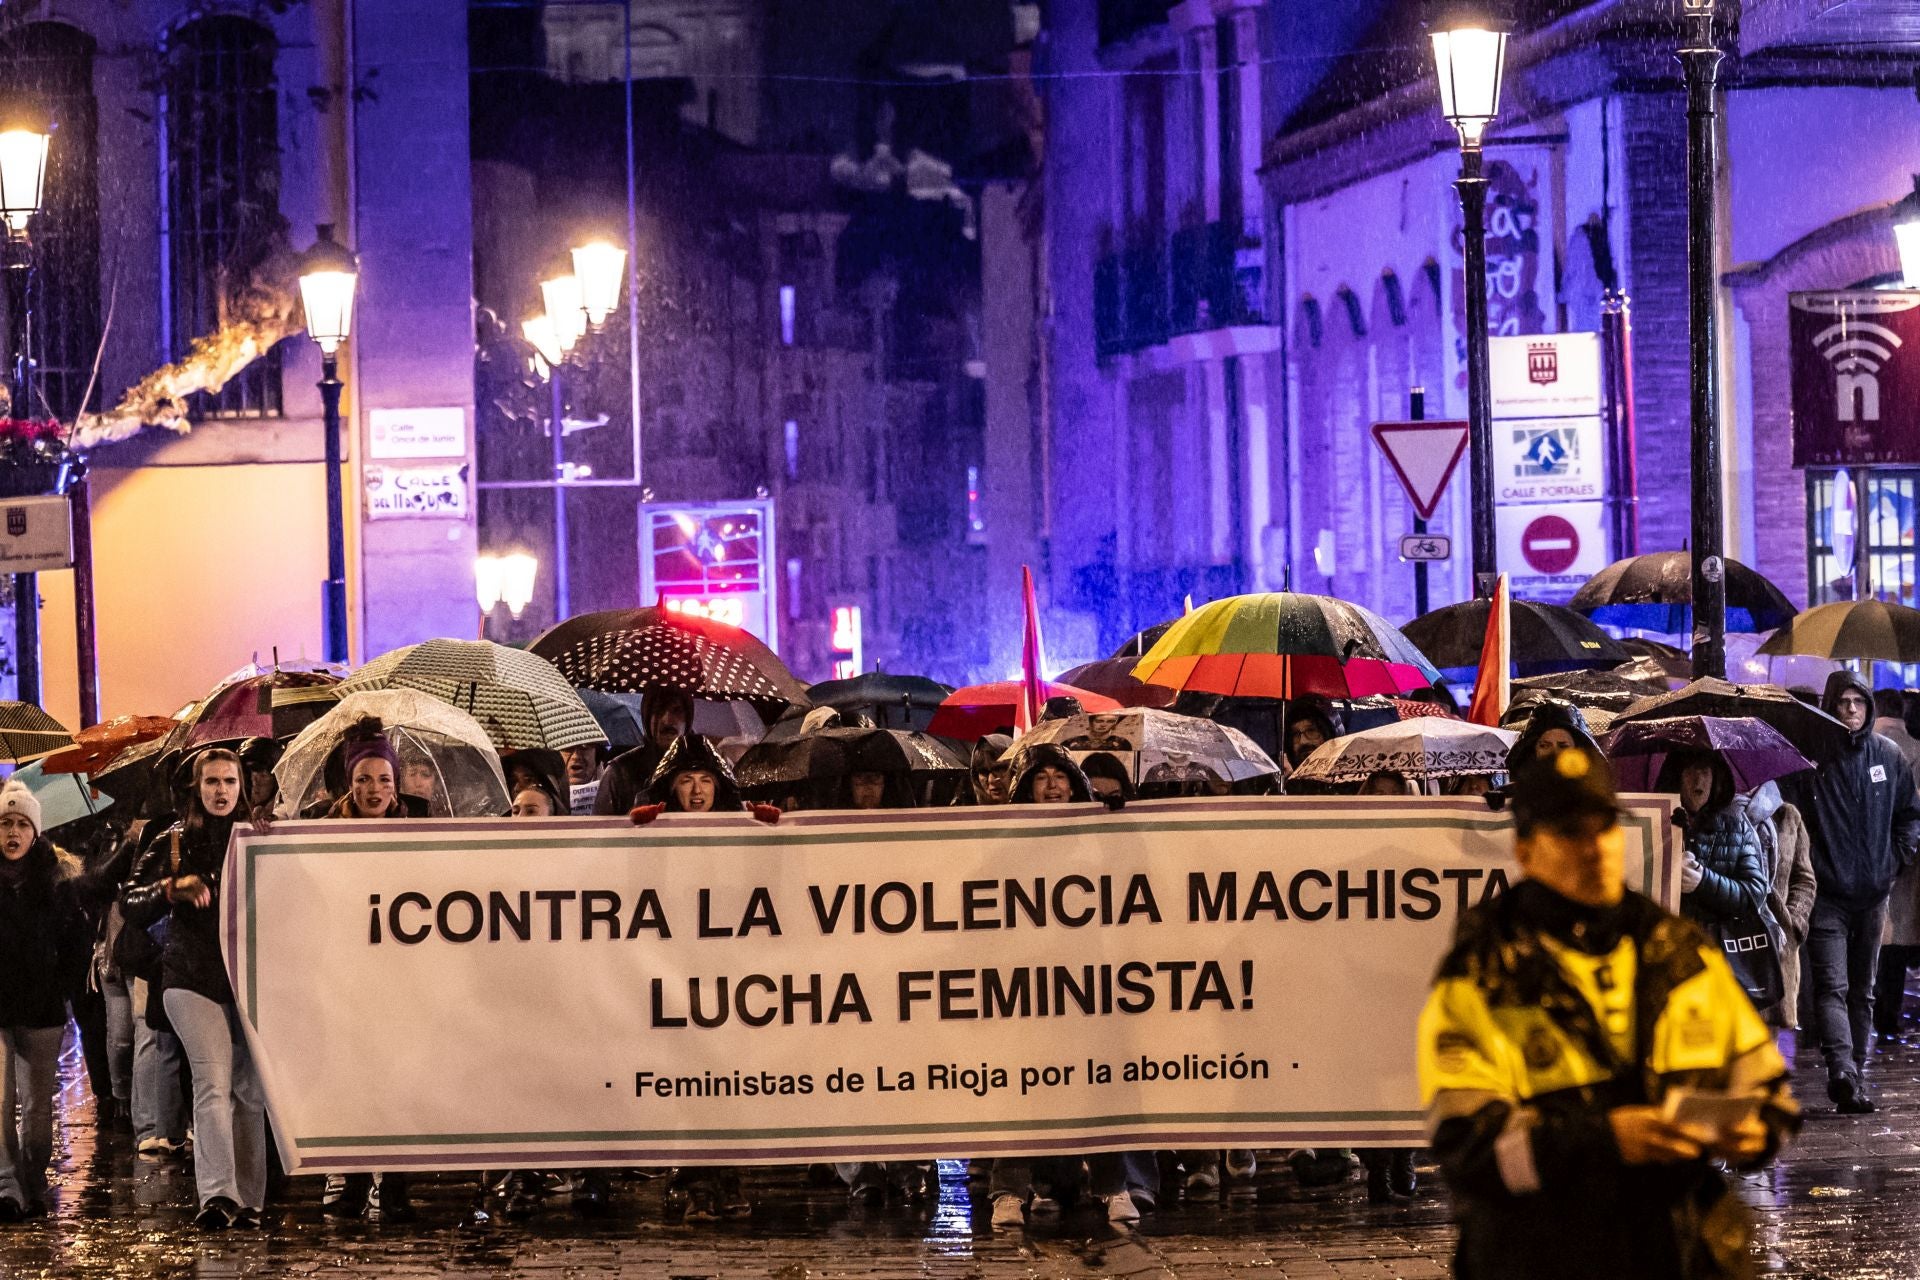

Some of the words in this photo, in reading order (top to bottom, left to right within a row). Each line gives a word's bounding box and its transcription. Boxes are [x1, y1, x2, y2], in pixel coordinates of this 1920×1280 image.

[1502, 487, 1536, 499] CALLE
[1541, 484, 1595, 496] PORTALES
[370, 889, 672, 945] ¡CONTRA
[698, 887, 783, 939] LA
[808, 874, 1163, 934] VIOLENCIA
[651, 973, 873, 1029] LUCHA
[898, 959, 1254, 1022] FEMINISTA!
[635, 1070, 814, 1098] Feministas
[825, 1067, 865, 1094] de
[877, 1066, 915, 1092] La
[927, 1062, 1008, 1097] Rioja
[1020, 1065, 1075, 1096] por
[1087, 1058, 1112, 1085] la
[1122, 1051, 1269, 1083] abolición
